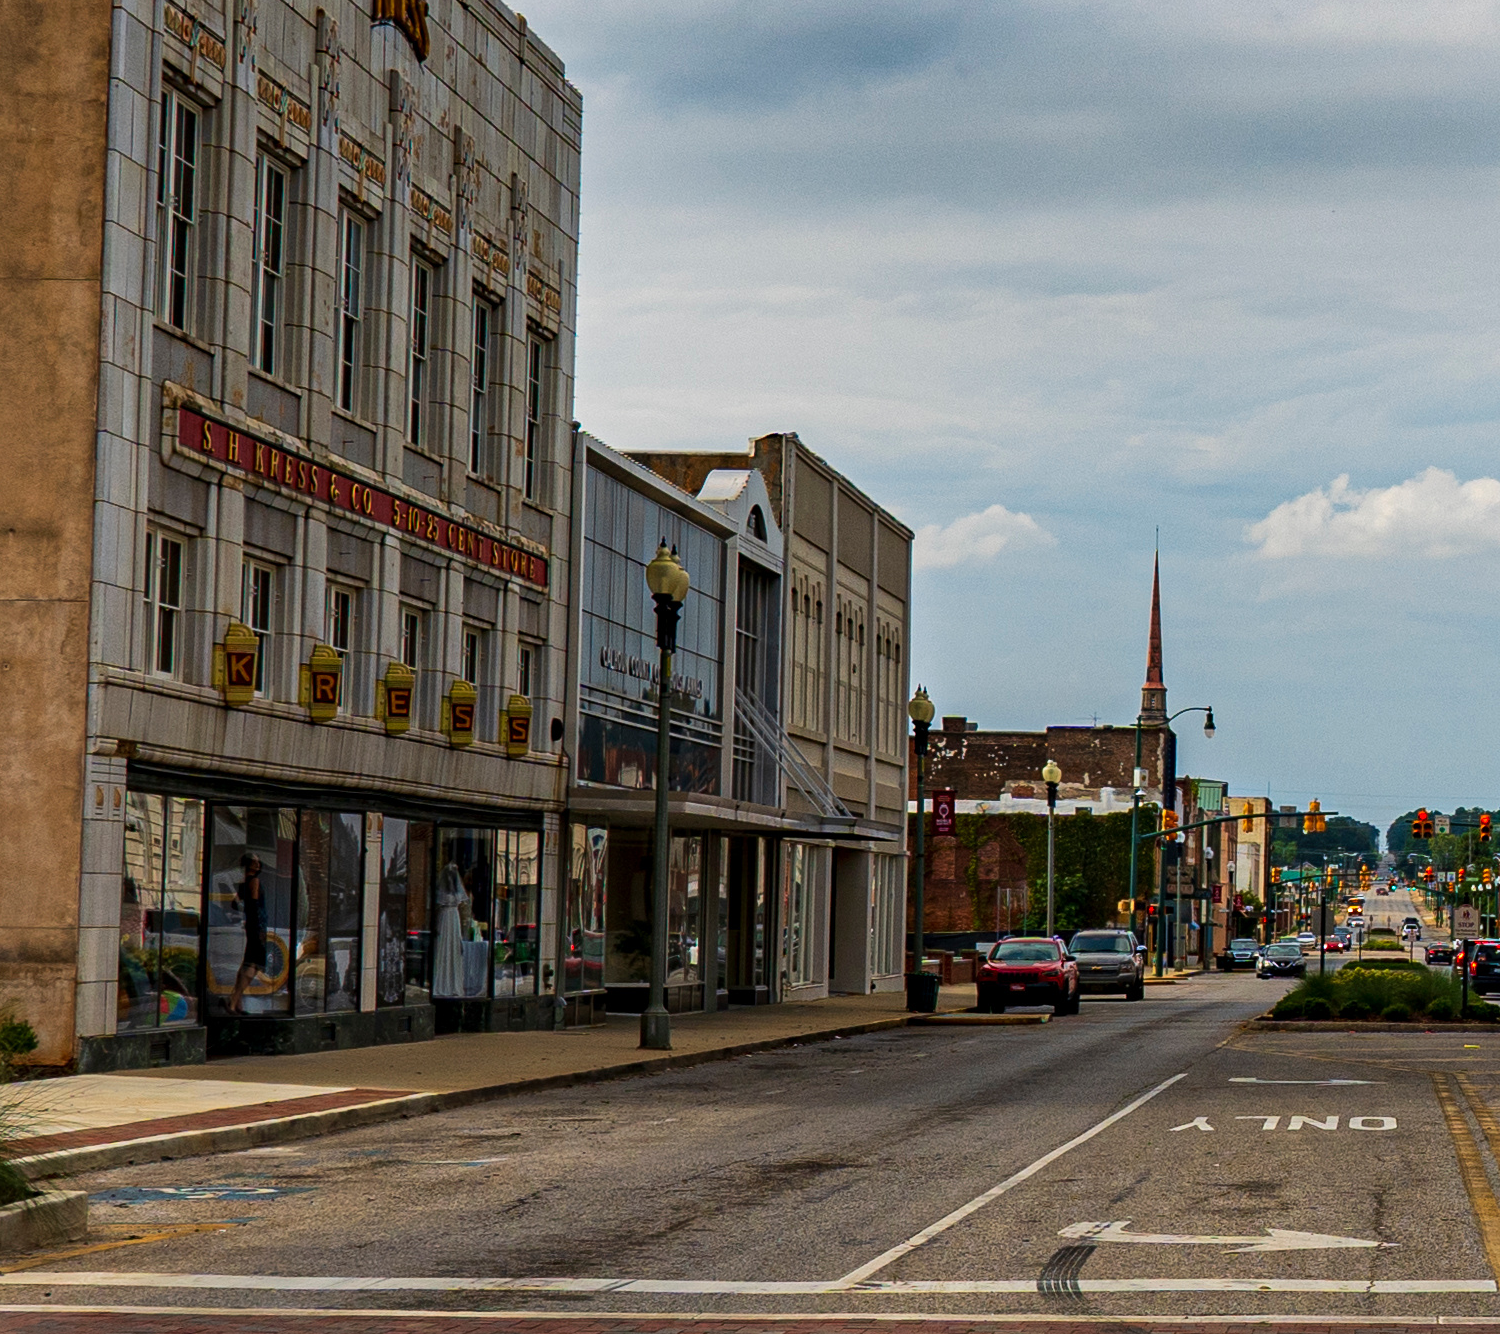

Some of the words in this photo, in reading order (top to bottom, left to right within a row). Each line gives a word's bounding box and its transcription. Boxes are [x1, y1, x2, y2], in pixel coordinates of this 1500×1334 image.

[203, 420, 215, 453] S.
[228, 430, 242, 464] H.
[254, 442, 318, 494] KRESS
[330, 473, 340, 502] &
[351, 483, 374, 515] CO.
[448, 523, 484, 559] CENT
[492, 542, 536, 579] STORE
[1169, 1115, 1398, 1132] ONLY
